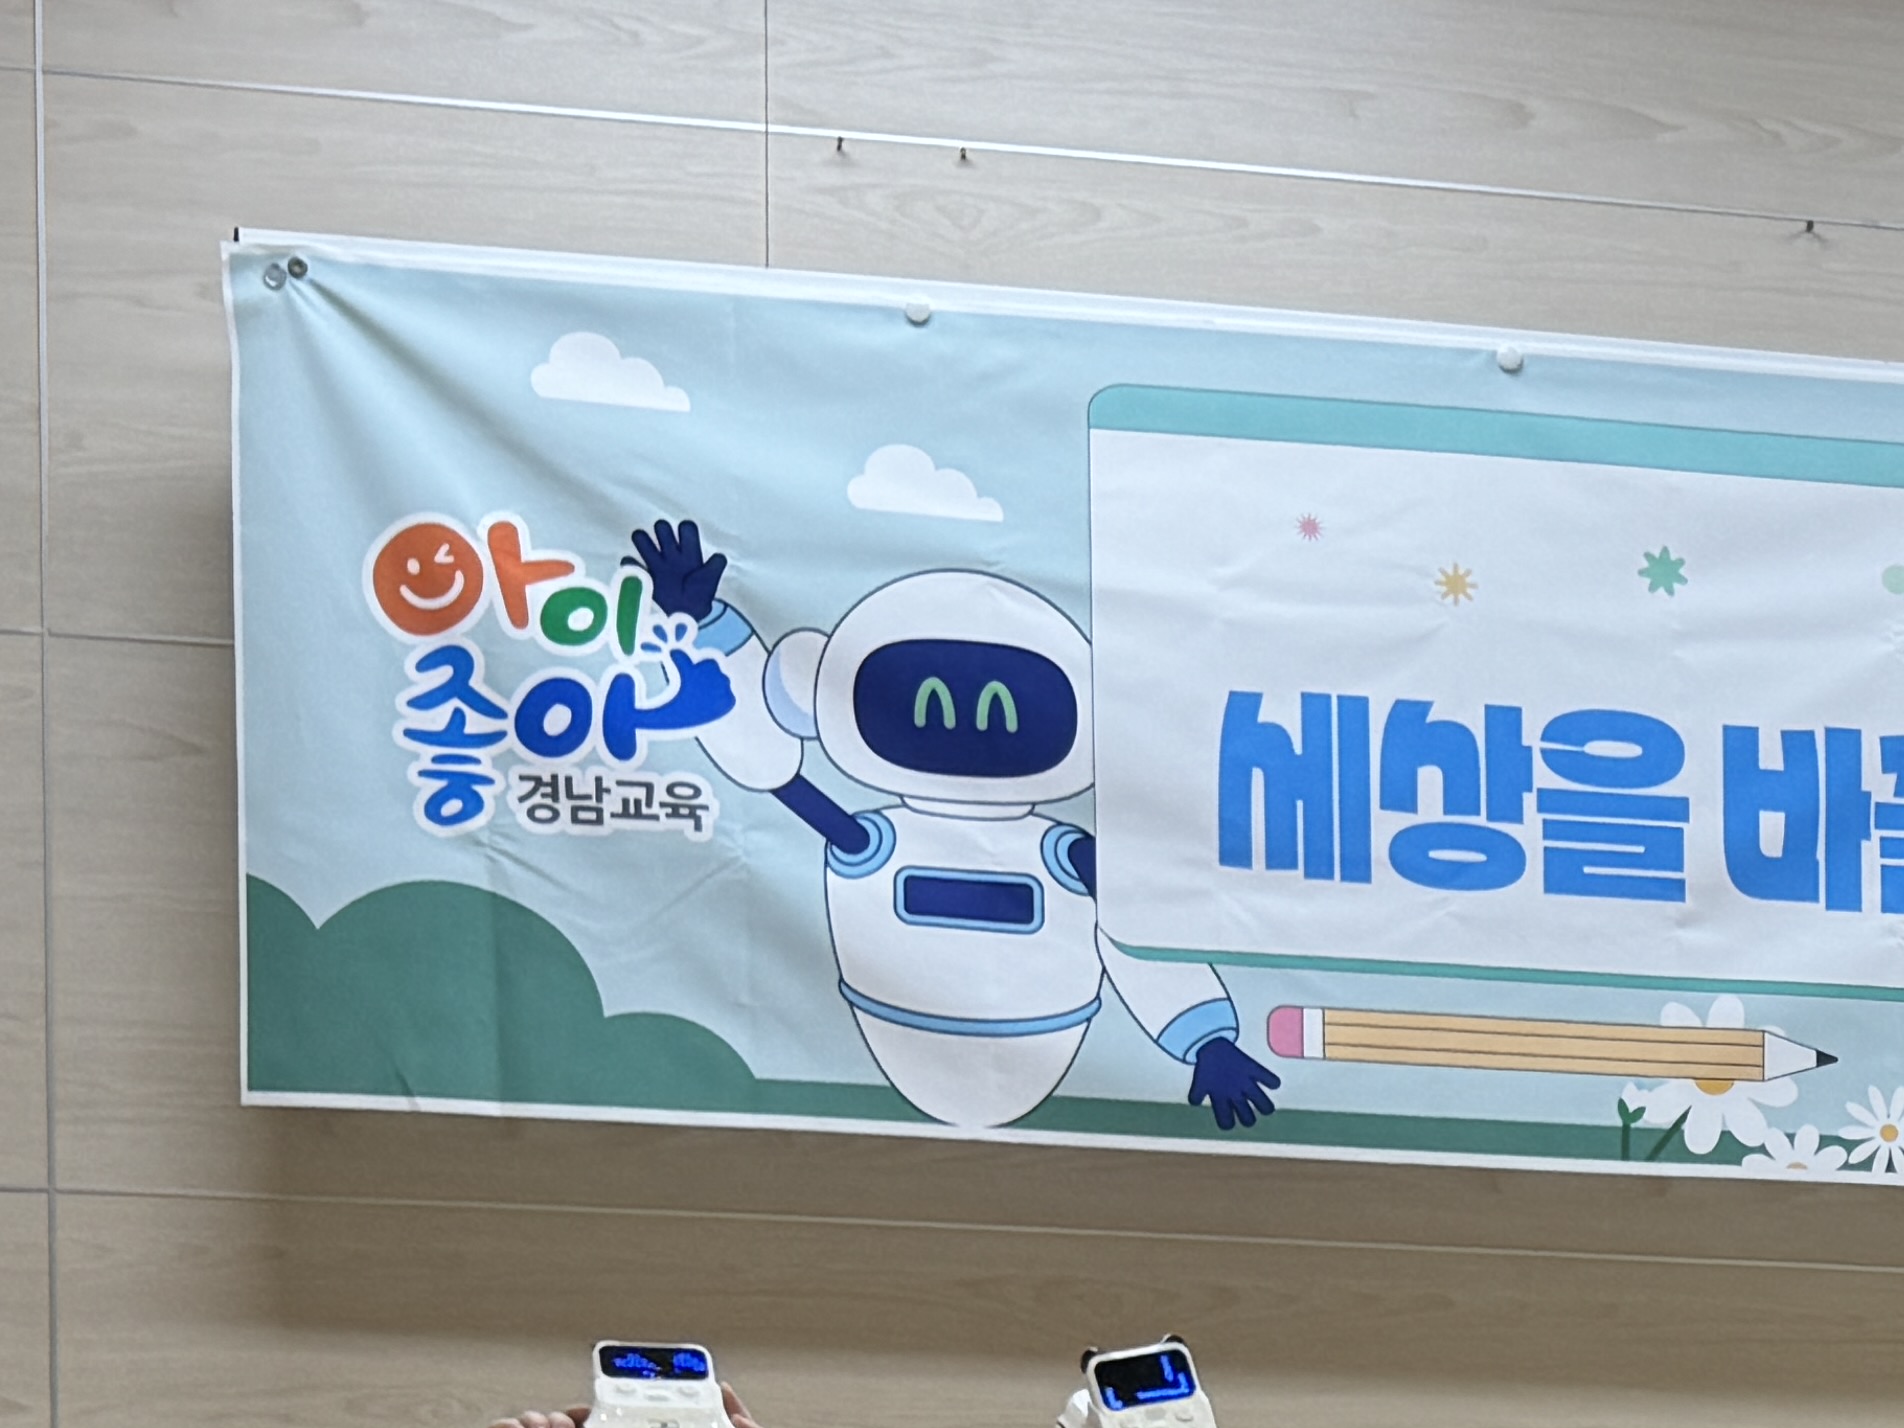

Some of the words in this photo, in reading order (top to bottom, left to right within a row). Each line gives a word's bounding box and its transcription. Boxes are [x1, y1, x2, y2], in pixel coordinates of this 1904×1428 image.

[373, 520, 643, 656] 아이
[403, 644, 736, 826] 좋아
[517, 774, 710, 832] 경남교육
[1219, 691, 1690, 903] 세상을
